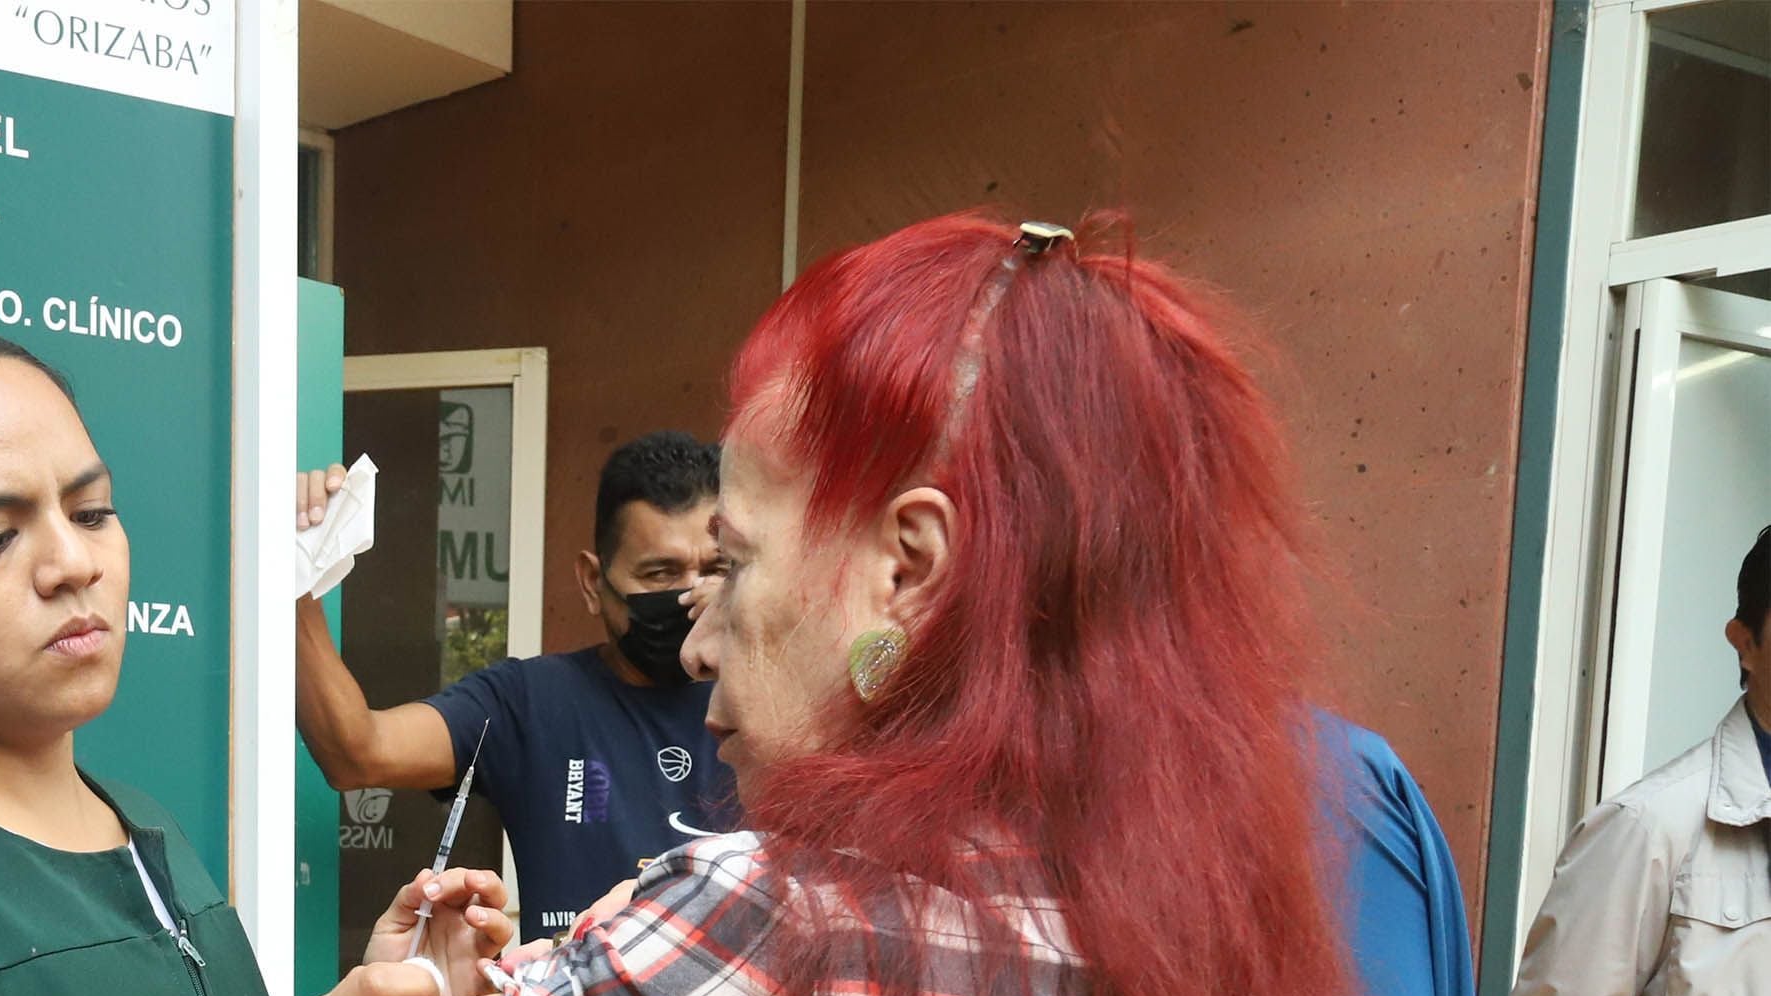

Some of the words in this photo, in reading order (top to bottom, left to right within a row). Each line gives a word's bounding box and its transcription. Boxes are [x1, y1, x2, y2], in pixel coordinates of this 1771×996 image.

[43, 292, 184, 349] CLÍNICO
[125, 600, 195, 637] NZA
[565, 759, 585, 824] BRYANT
[542, 911, 577, 928] DAVIS
